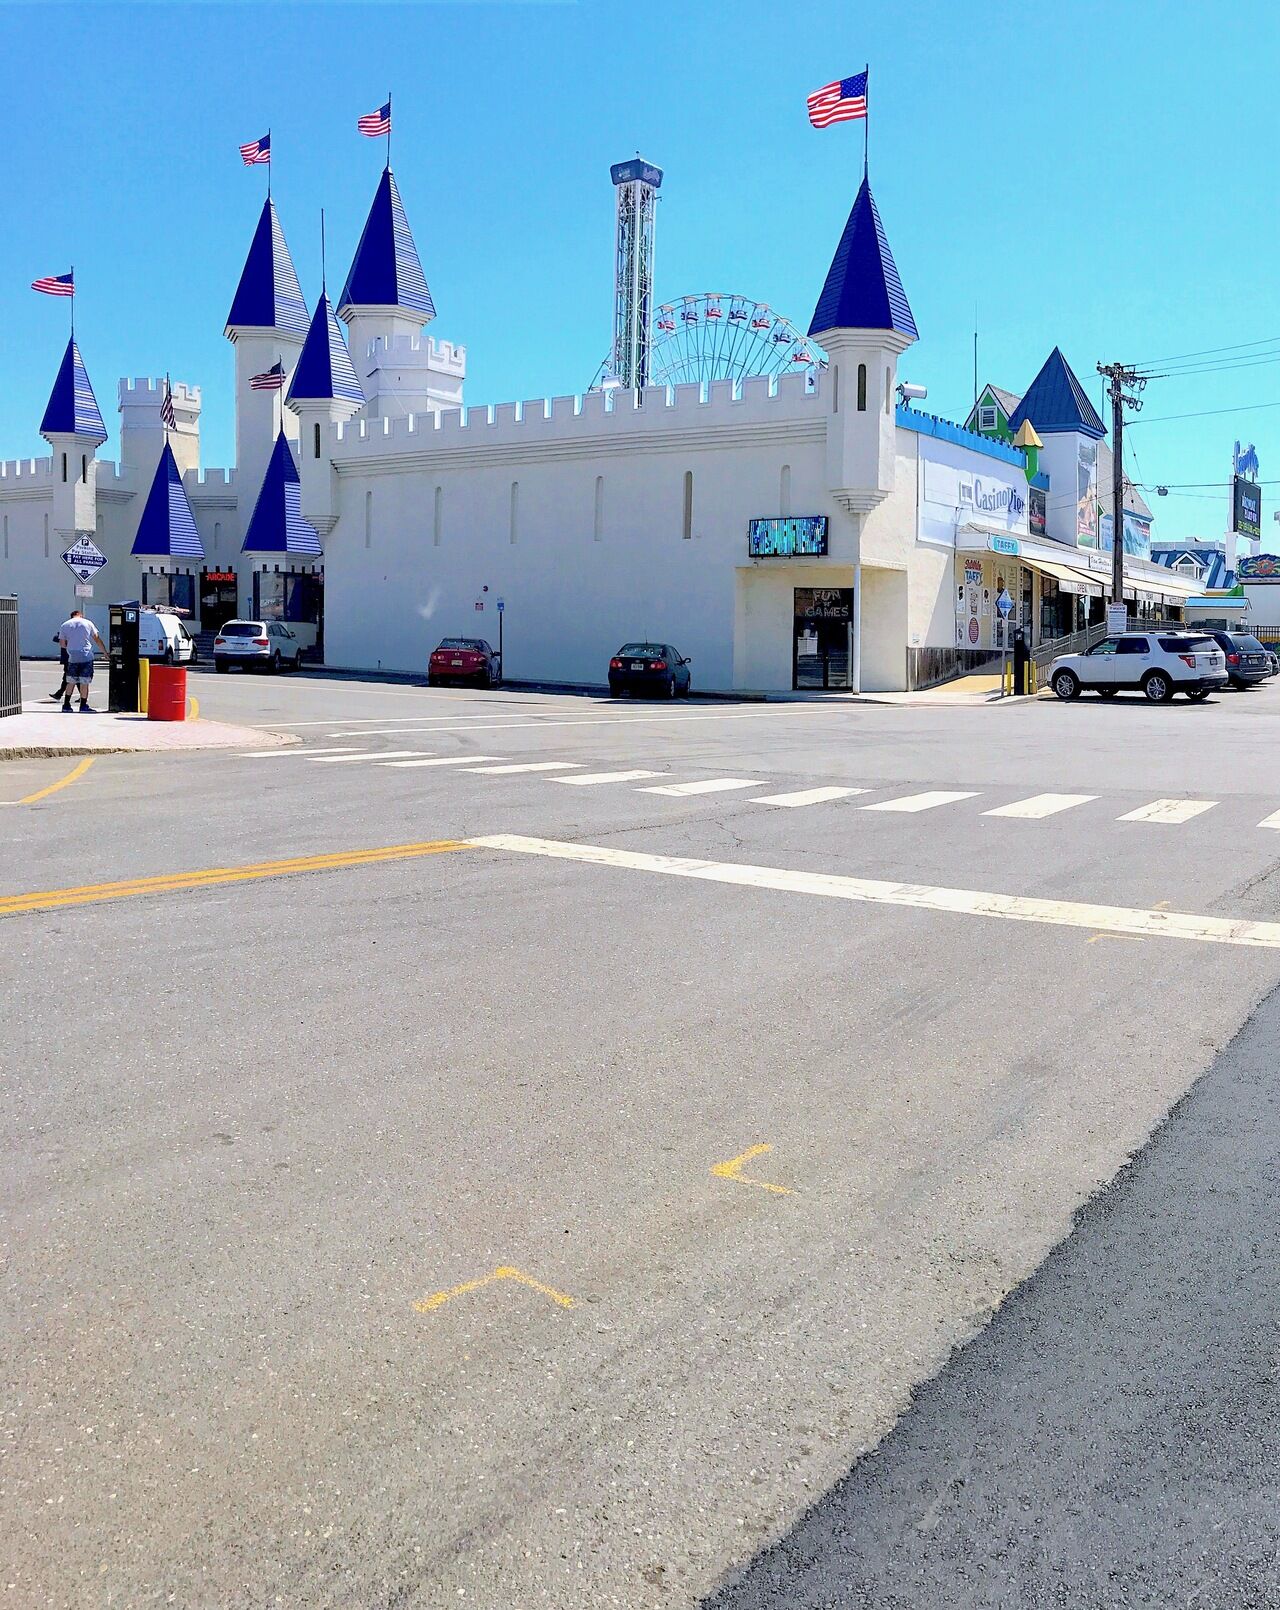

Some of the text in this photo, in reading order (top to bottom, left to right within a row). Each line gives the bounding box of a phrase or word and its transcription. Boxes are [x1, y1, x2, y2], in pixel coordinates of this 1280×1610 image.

[996, 540, 1015, 551] TAFFY
[206, 573, 237, 582] ARCADE
[813, 589, 841, 601] FUN
[804, 606, 849, 617] GAMES
